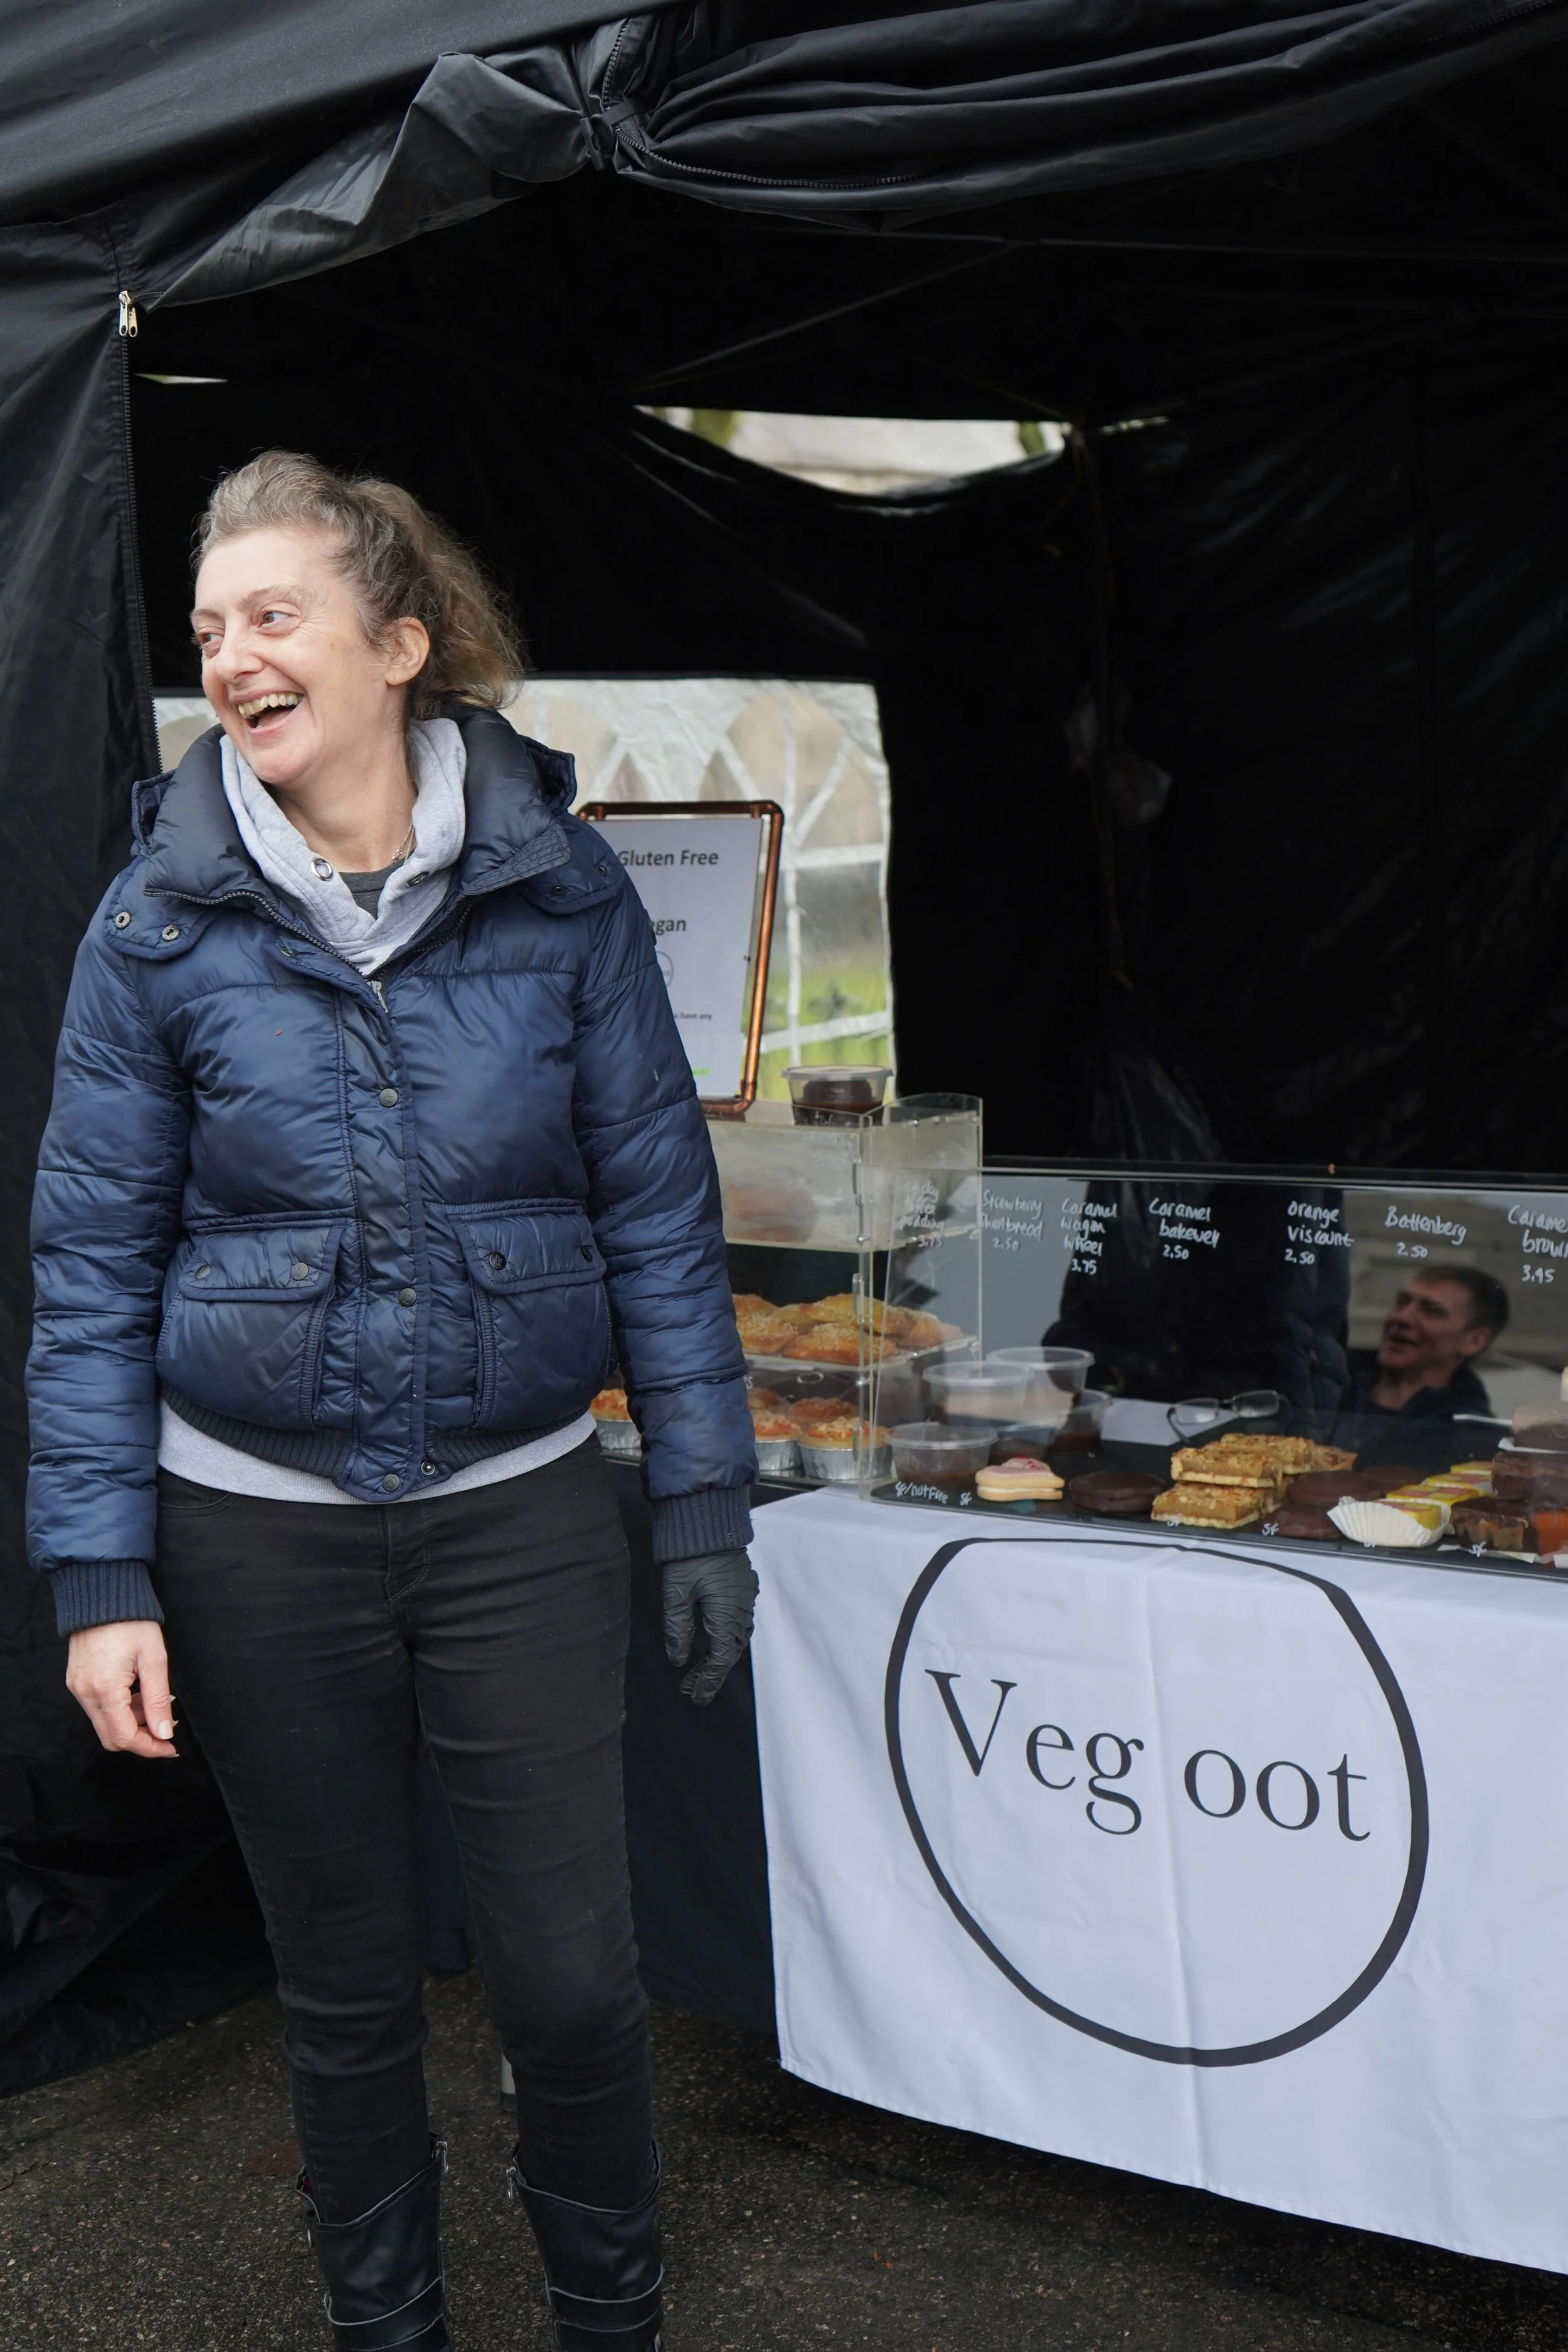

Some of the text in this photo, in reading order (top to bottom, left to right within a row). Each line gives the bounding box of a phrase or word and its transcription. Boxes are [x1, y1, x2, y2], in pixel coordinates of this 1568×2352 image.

[617, 850, 719, 866] Gluten Free
[1061, 1198, 1117, 1218] Caramel
[1148, 1197, 1211, 1222] Caramel
[1384, 1205, 1467, 1246] Battenberg
[1507, 1204, 1568, 1234] Carame
[1162, 1244, 1190, 1260] 2.50
[1284, 1248, 1315, 1265] 2.50
[1397, 1242, 1428, 1258] 2.50
[1071, 1258, 1097, 1275] 3.75
[924, 1668, 1371, 1841] Veg oot
